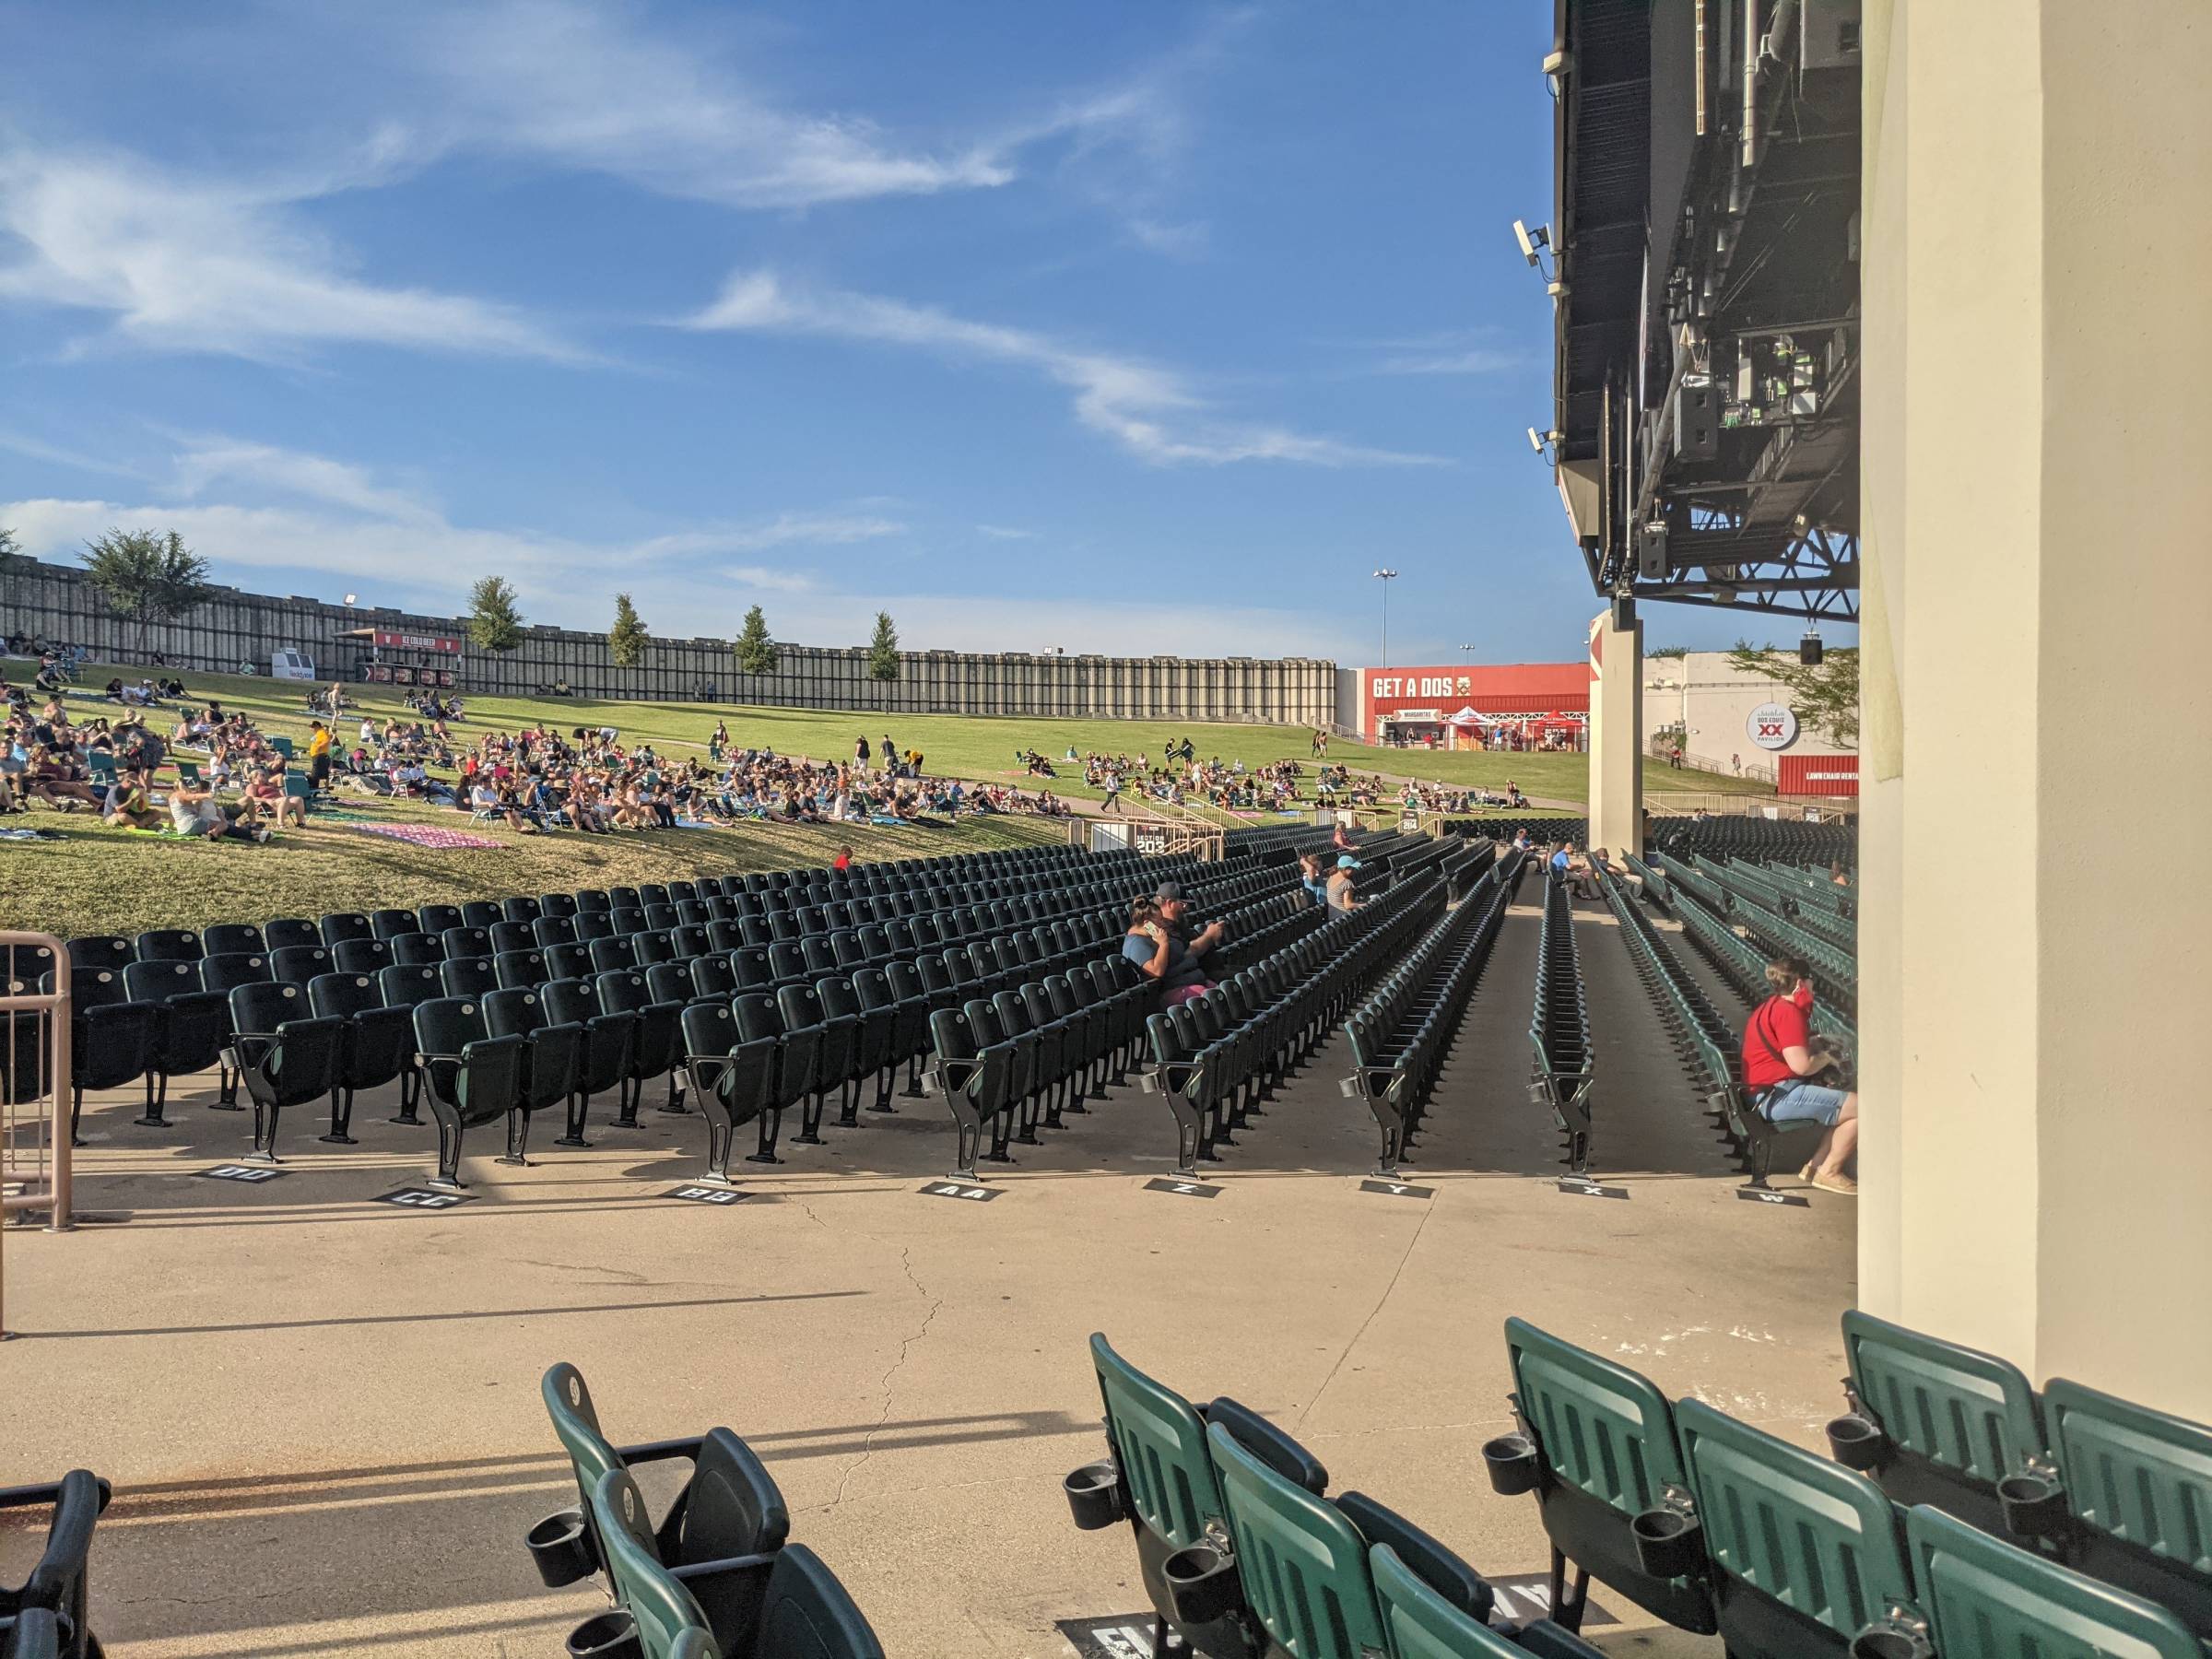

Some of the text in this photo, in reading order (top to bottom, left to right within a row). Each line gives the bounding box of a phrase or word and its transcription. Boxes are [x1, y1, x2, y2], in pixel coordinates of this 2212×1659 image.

[410, 636, 422, 645] COLD
[423, 637, 436, 646] BEER
[1372, 677, 1453, 698] GET A DOS
[1758, 724, 1784, 736] XX
[1806, 771, 1823, 781] LAWN
[1823, 771, 1841, 781] CHAIR
[1136, 841, 1165, 853] 203
[934, 1185, 986, 1199] AA
[1172, 1182, 1197, 1194] Z
[1388, 1184, 1408, 1194] Y
[1583, 1186, 1603, 1195] X
[391, 1192, 460, 1206] CC
[676, 1187, 739, 1202] BB
[1759, 1193, 1785, 1203] W
